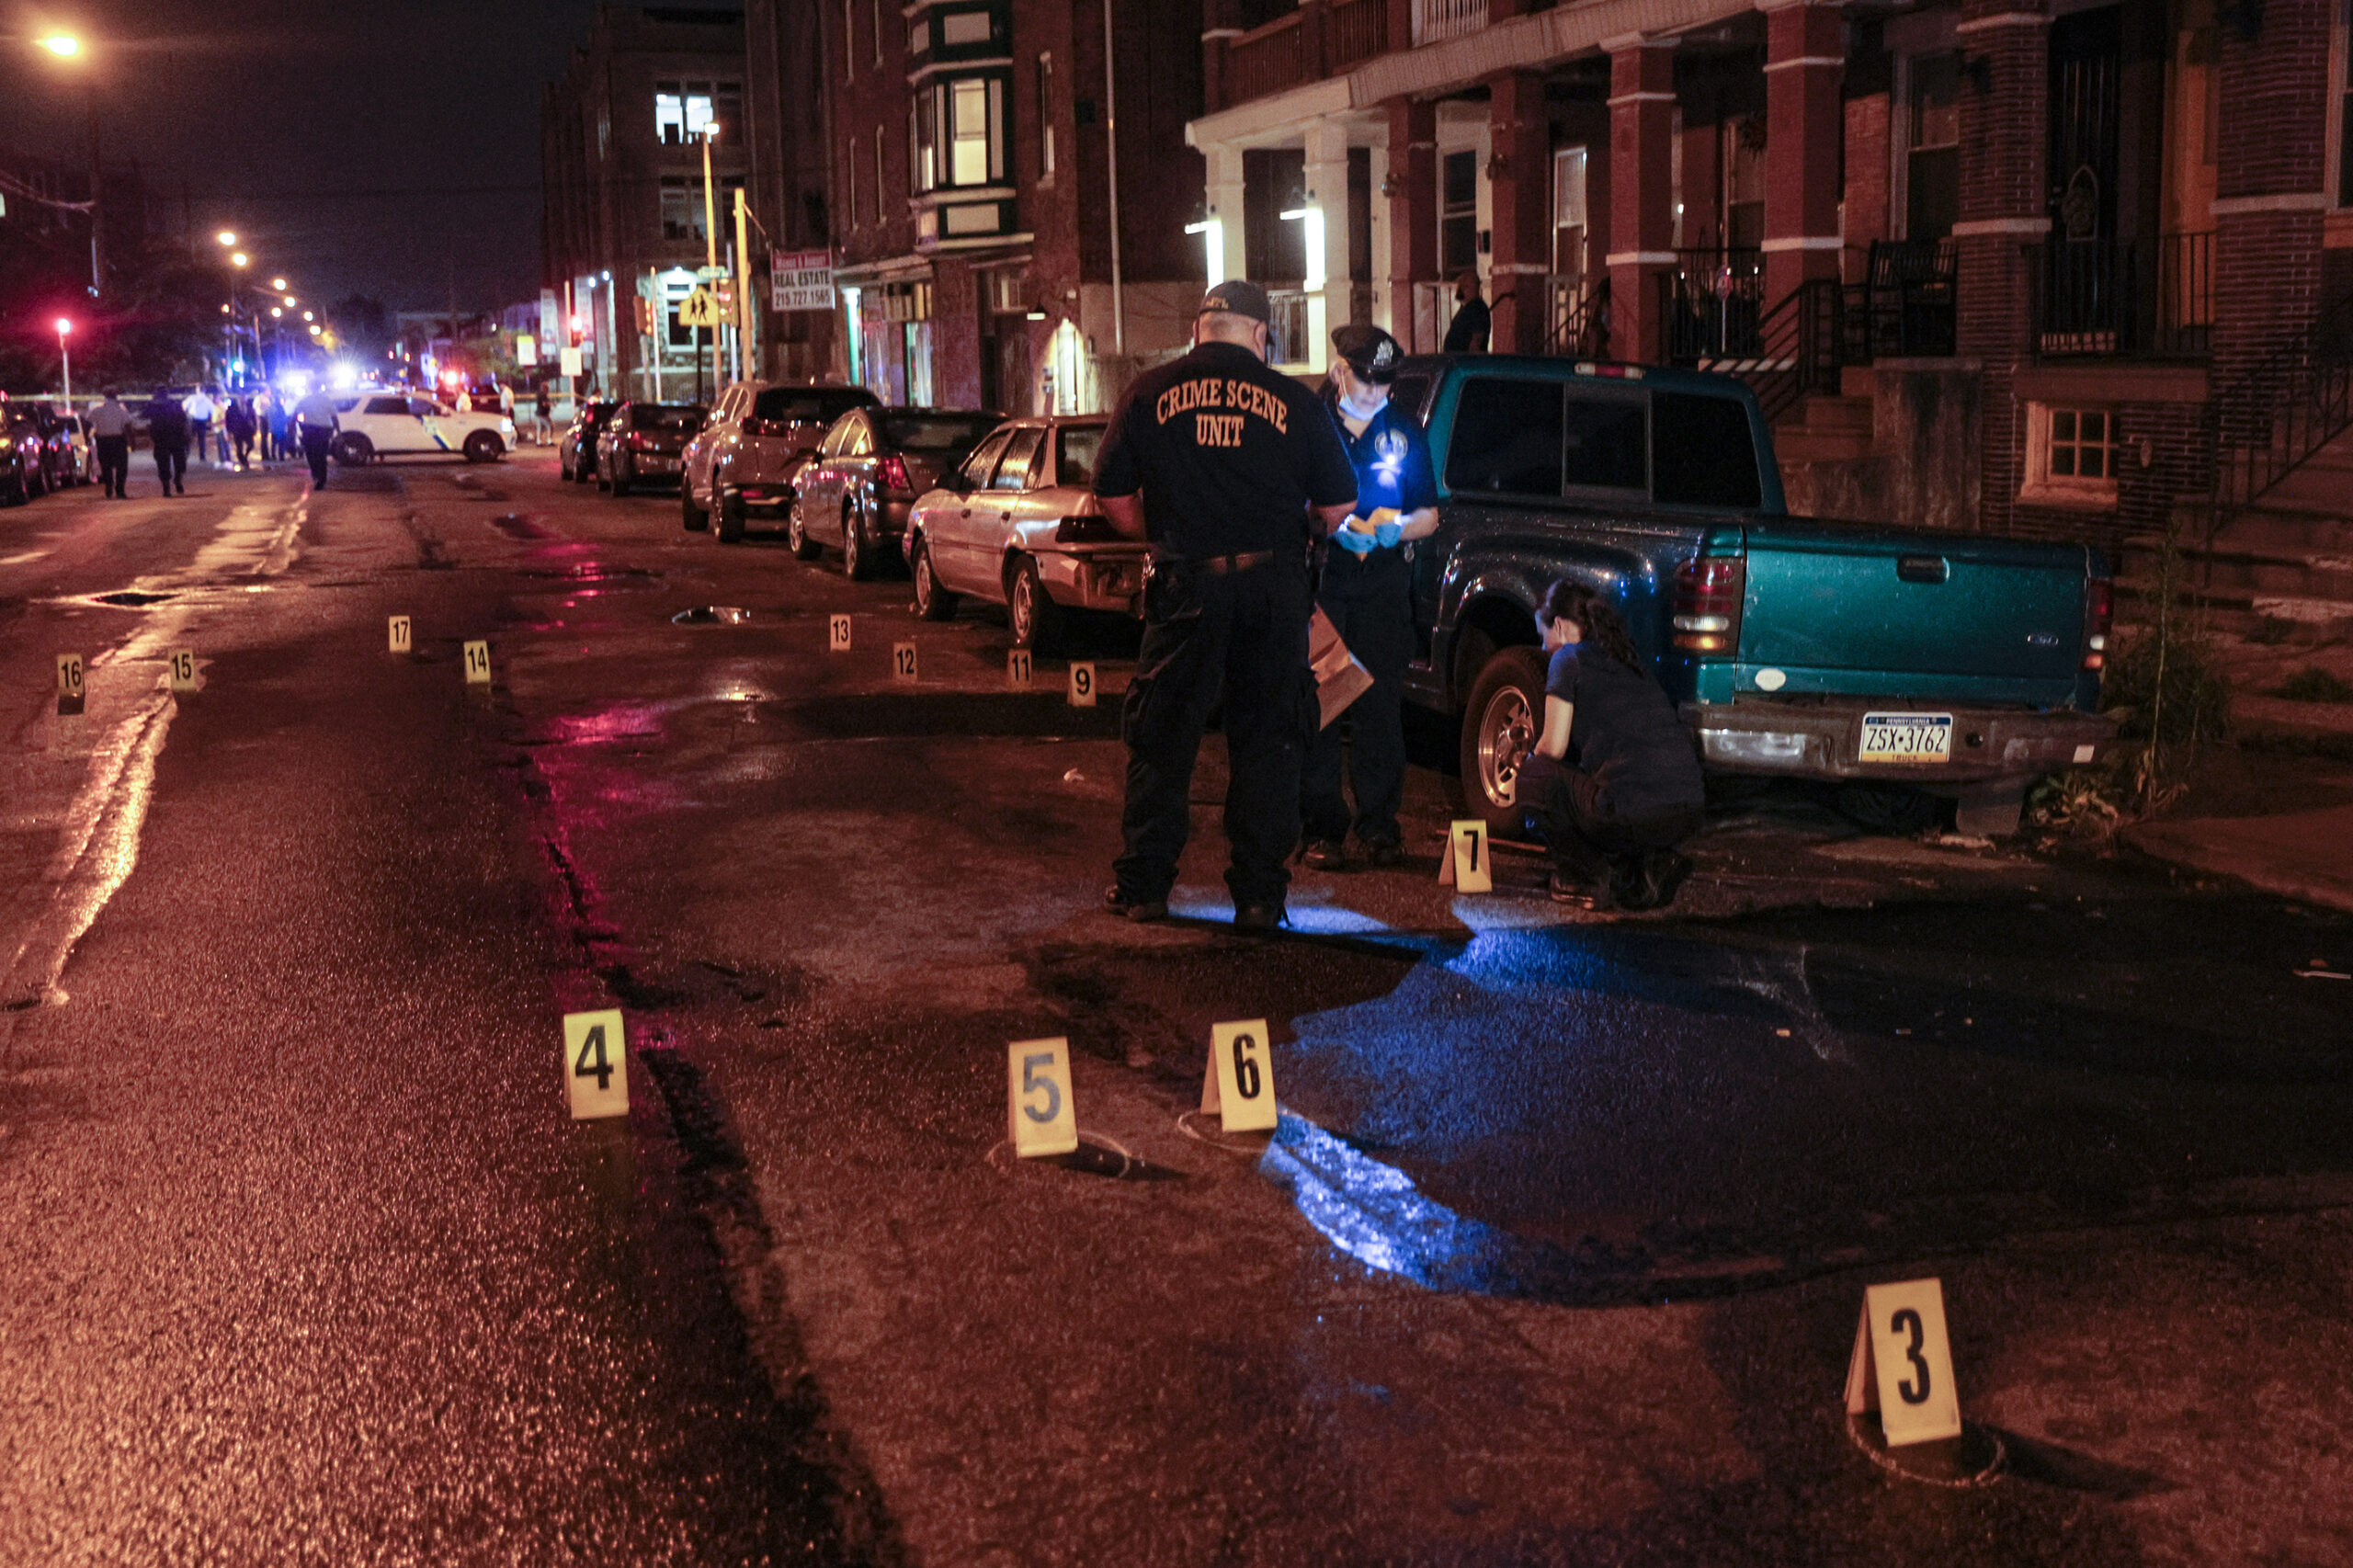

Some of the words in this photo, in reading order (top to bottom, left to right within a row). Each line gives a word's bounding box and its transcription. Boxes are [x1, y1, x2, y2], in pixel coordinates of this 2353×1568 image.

[774, 271, 796, 288] REAL
[798, 269, 830, 287] ESTATE
[1156, 378, 1222, 426] CRIME
[1226, 379, 1288, 435] SCENE
[1196, 414, 1245, 448] UNIT
[393, 620, 409, 643] 17
[833, 619, 848, 642] 13
[172, 653, 192, 681] 15
[468, 646, 487, 674] 14
[896, 649, 915, 675] 12
[1012, 654, 1029, 681] 11
[61, 661, 82, 688] 16
[1075, 668, 1091, 696] 9
[1463, 830, 1479, 871] 7
[575, 1025, 614, 1090] 4
[1233, 1033, 1261, 1099] 6
[1023, 1052, 1061, 1124] 5
[1891, 1307, 1930, 1404] 3
